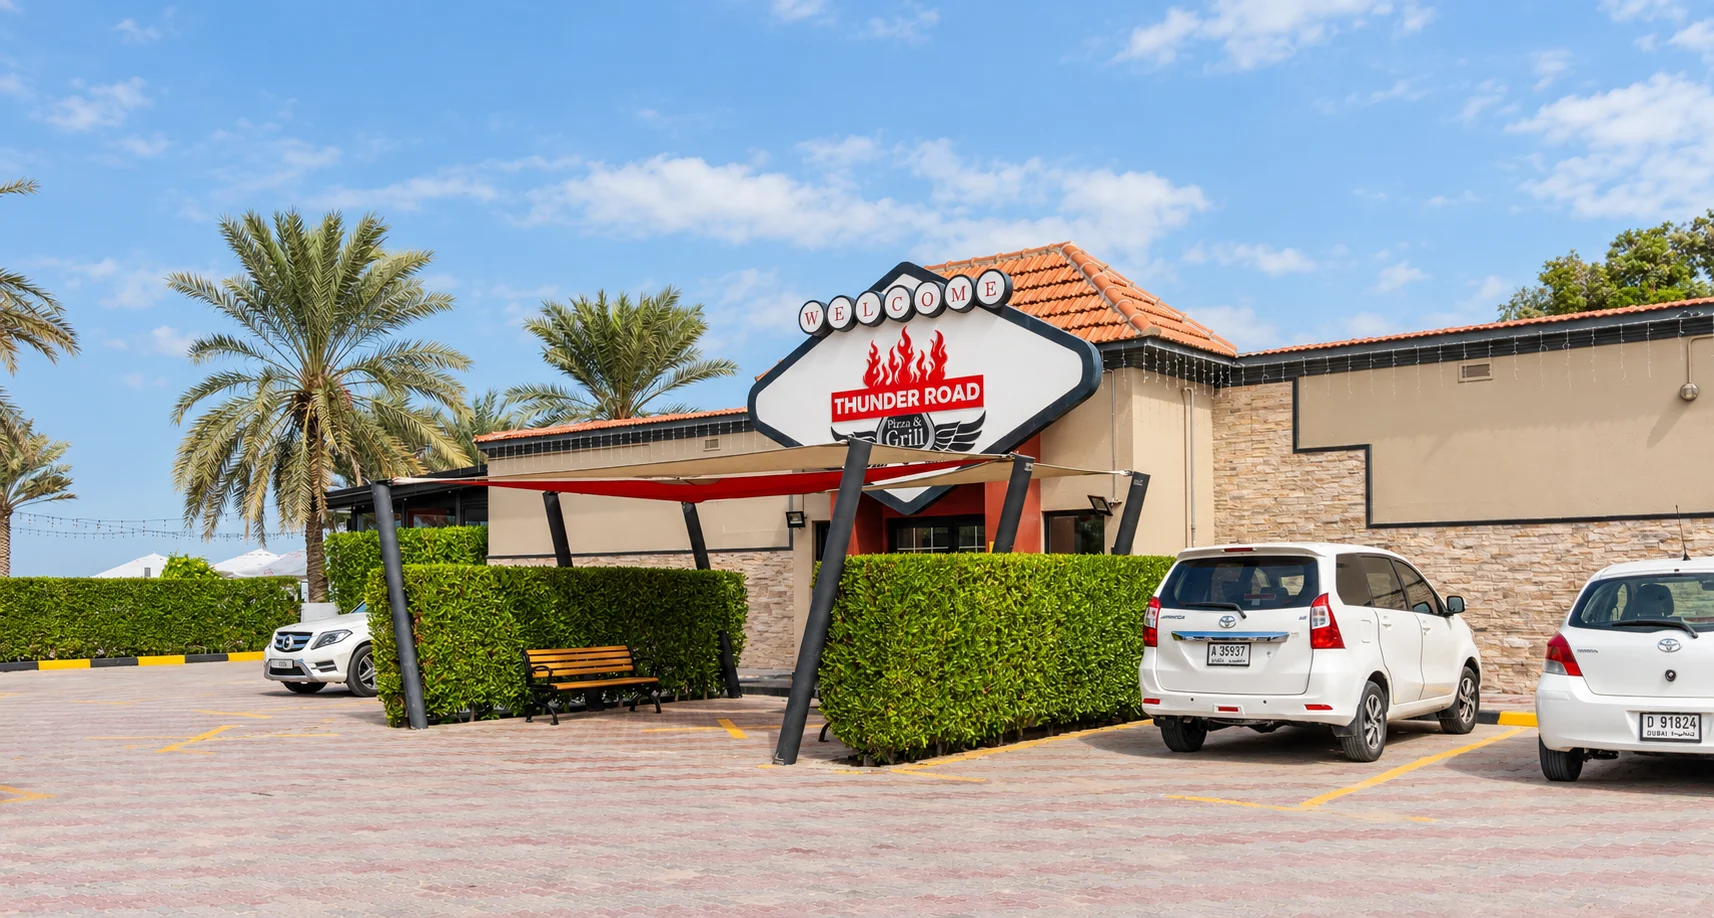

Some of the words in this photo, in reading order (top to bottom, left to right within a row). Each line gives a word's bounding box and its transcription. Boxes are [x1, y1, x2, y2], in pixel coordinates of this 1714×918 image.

[804, 280, 997, 326] WELCOME
[834, 389, 920, 415] THUNDER
[924, 382, 981, 405] ROAD
[887, 418, 911, 429] Pizza
[913, 416, 922, 427] &
[886, 427, 925, 447] Grill
[1210, 645, 1217, 657] A
[1219, 645, 1246, 657] 35937
[1647, 715, 1654, 728] D
[1660, 715, 1697, 730] 91824
